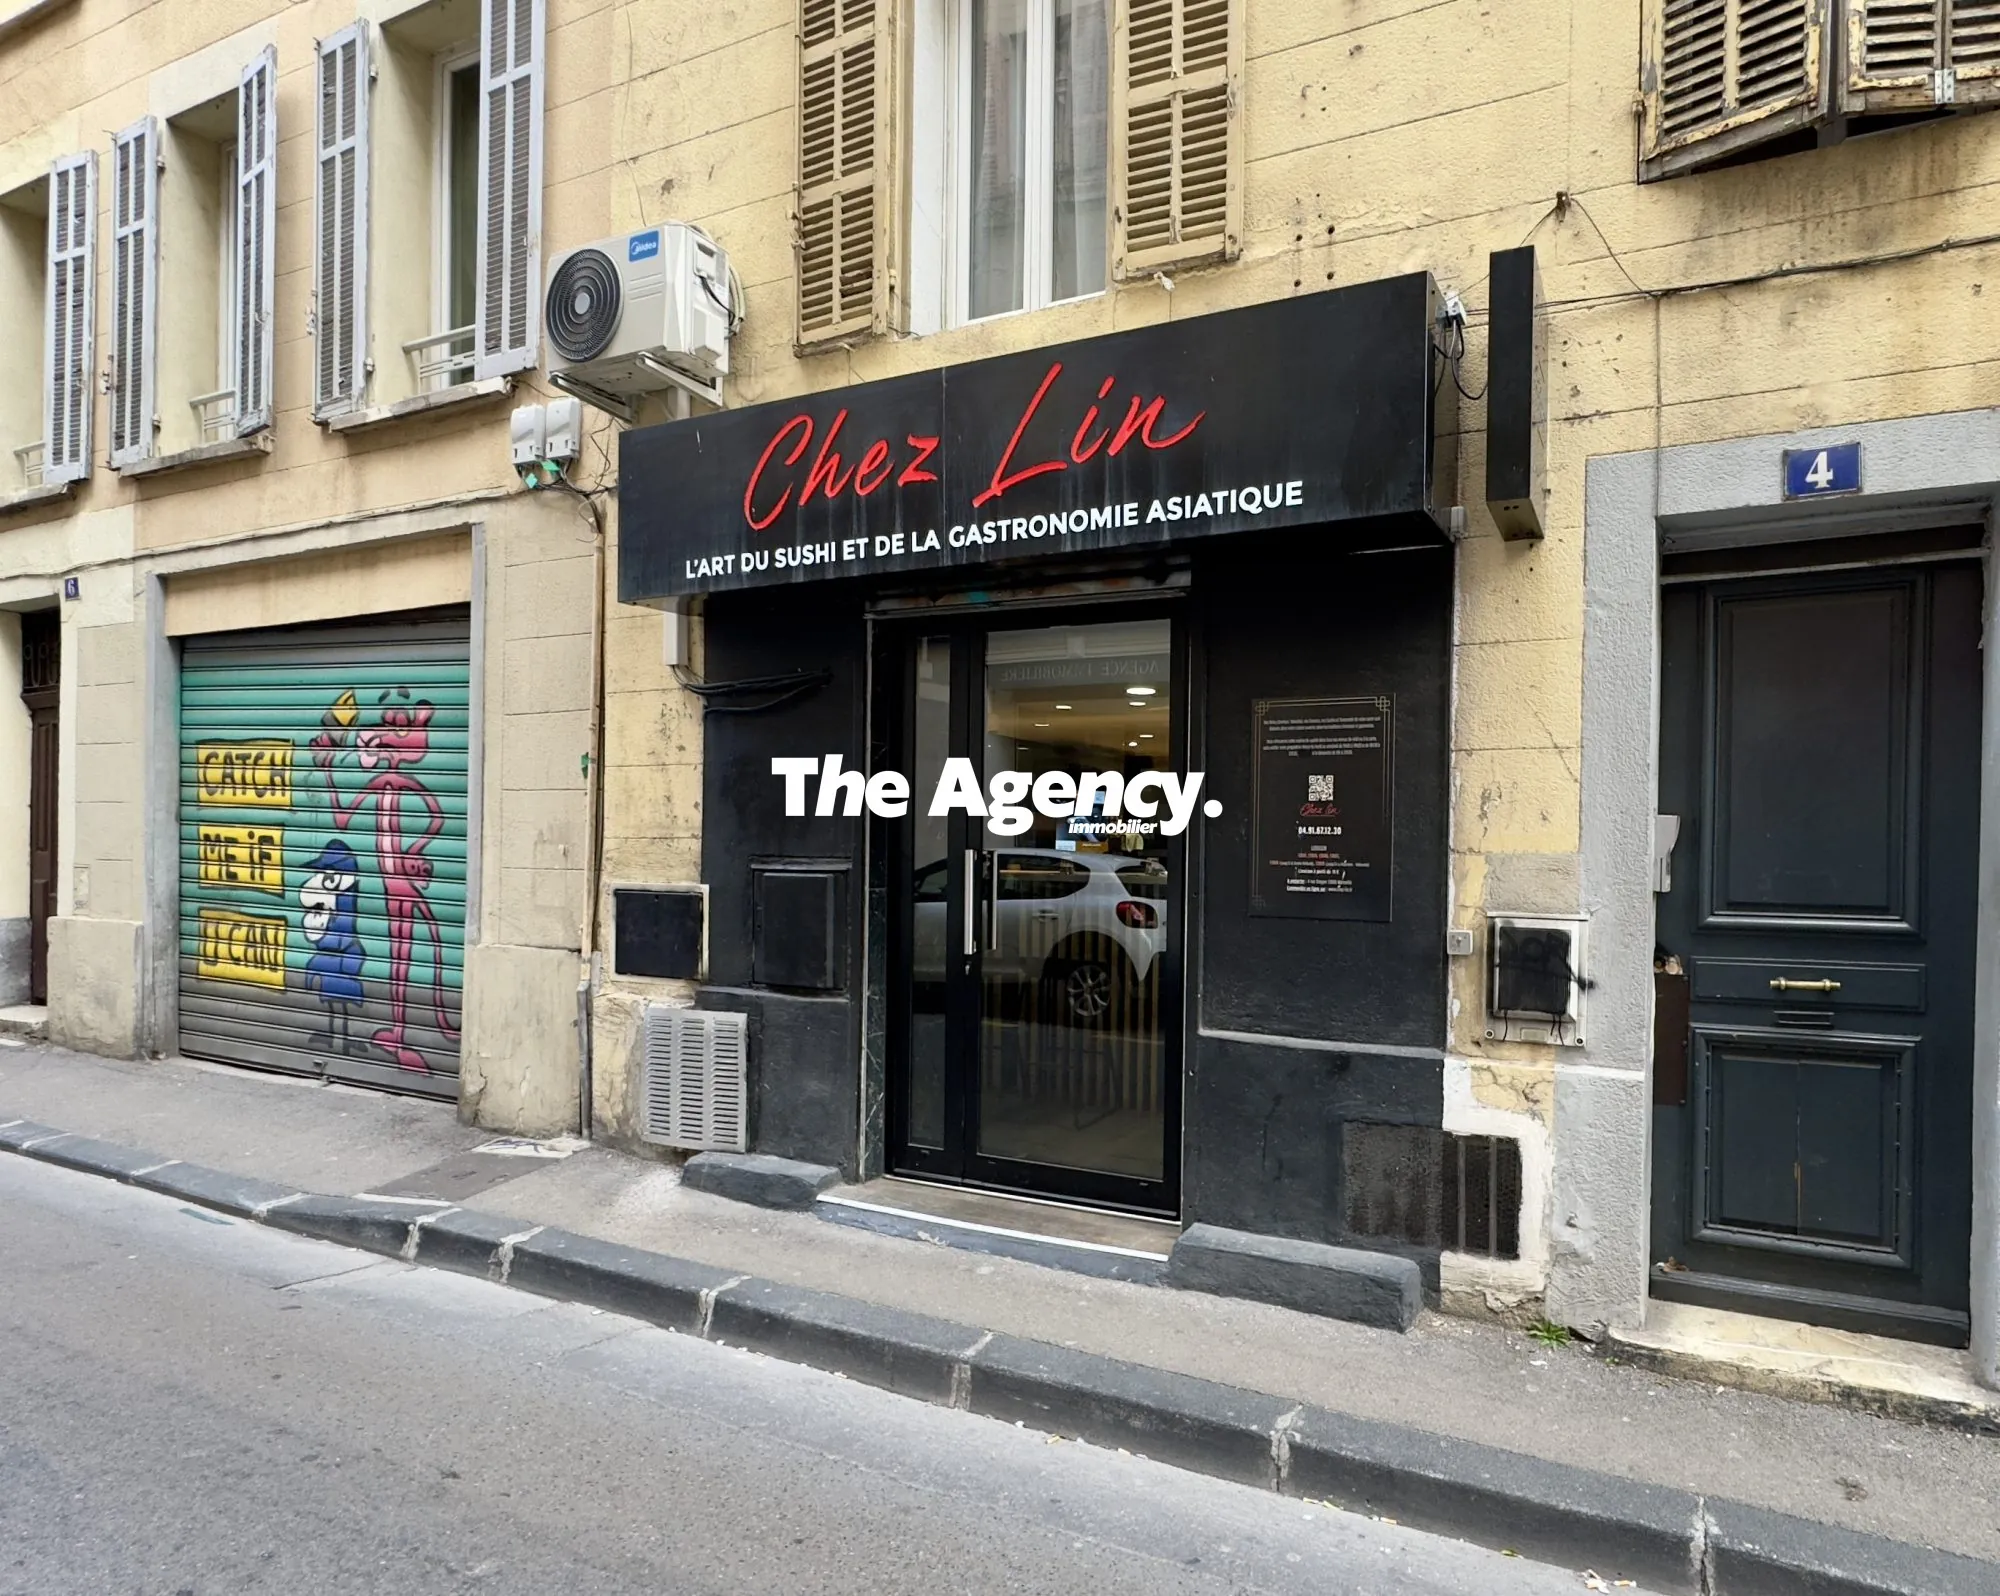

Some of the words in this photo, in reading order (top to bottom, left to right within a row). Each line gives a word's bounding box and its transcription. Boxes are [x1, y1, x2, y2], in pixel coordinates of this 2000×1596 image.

[744, 408, 940, 531] Chez
[972, 362, 1206, 508] Lin
[1805, 451, 1833, 489] 4
[685, 554, 735, 579] L'ART
[740, 549, 769, 573] DU
[774, 540, 836, 568] SUSHI
[842, 537, 869, 561] ET
[875, 533, 905, 556] DE
[911, 529, 941, 552] LA
[948, 502, 1139, 549] GASTRONOMIE
[1145, 480, 1304, 525] ASIATIQUE
[67, 579, 76, 597] 6
[203, 751, 287, 798] CATCH
[203, 833, 239, 880] ME
[203, 920, 219, 966] U
[229, 923, 279, 973] CAN
